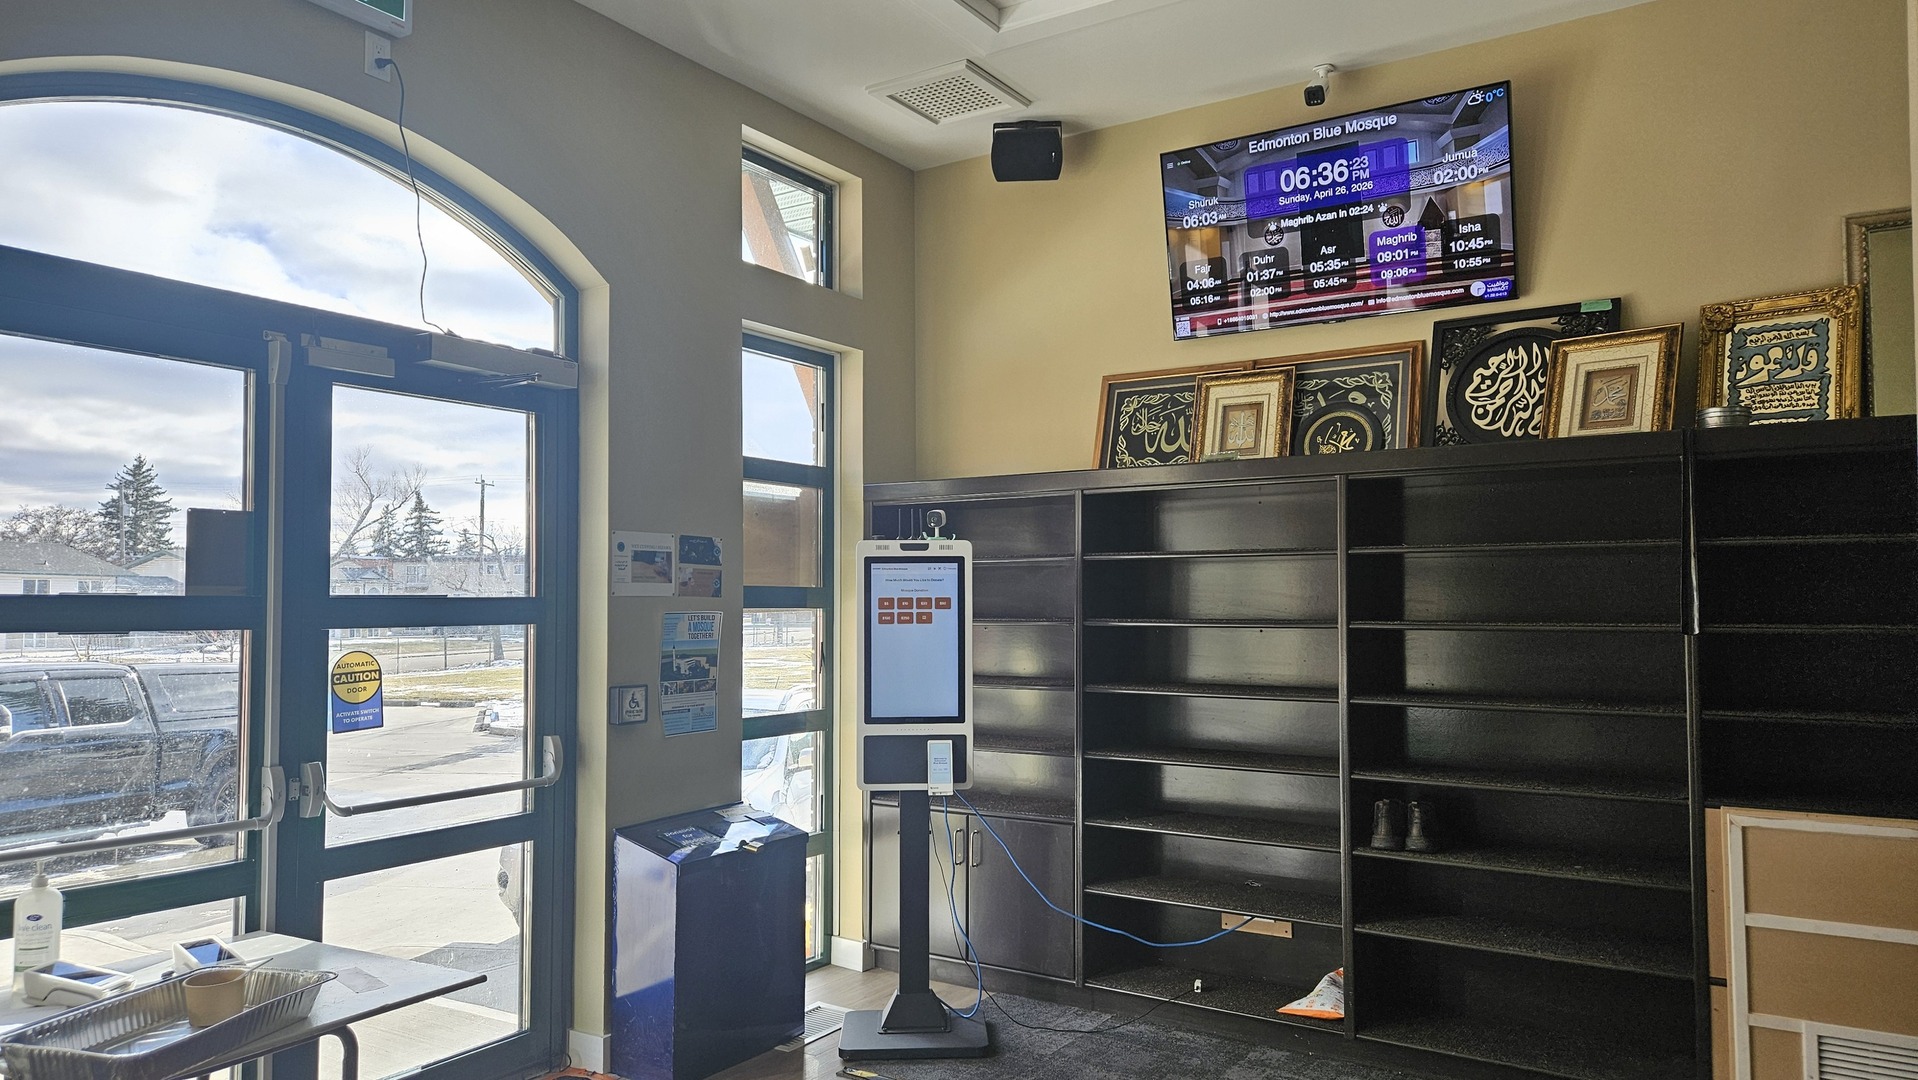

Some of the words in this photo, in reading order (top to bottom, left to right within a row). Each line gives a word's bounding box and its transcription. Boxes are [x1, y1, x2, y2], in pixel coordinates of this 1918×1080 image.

[1249, 132, 1310, 153] Edmonton
[1313, 125, 1342, 140] Blue
[1345, 114, 1398, 134] Mosque
[1442, 149, 1478, 164] Jumua
[1280, 158, 1349, 193] 06:36
[1352, 168, 1370, 181] PM
[1433, 164, 1478, 186] 02:00
[1478, 166, 1489, 175] PM
[1279, 192, 1312, 206] Sunday,
[1313, 188, 1333, 201] April
[1335, 184, 1349, 196] 26,
[1351, 181, 1373, 193] 2026
[1188, 197, 1219, 210] Shuruk
[1182, 211, 1218, 229] 06:03
[1280, 214, 1314, 228] Maghrib
[1315, 211, 1337, 223] Azan
[1348, 204, 1374, 216] 02:24
[1458, 222, 1482, 234] Isha
[1376, 231, 1418, 247] Maghrib
[1449, 237, 1485, 253] 10:45
[1320, 245, 1337, 256] Asr
[1376, 248, 1410, 264] 09:01
[1253, 254, 1275, 265] Duhr
[1309, 258, 1341, 273] 05:35
[1453, 256, 1482, 269] 10:55
[1194, 264, 1212, 275] Fajr
[1246, 268, 1276, 283] 01:37
[1313, 276, 1340, 289] 05:45
[1250, 286, 1275, 298] 02:00
[1190, 294, 1213, 306] 05:16
[693, 622, 714, 632] MOSQUE
[336, 660, 375, 669] AUTOMATIC
[333, 671, 379, 684] CAUTION
[347, 686, 367, 694] DOOR
[336, 710, 360, 718] ACTIVATE
[351, 715, 373, 723] OPERATE
[31, 923, 53, 932] clean
